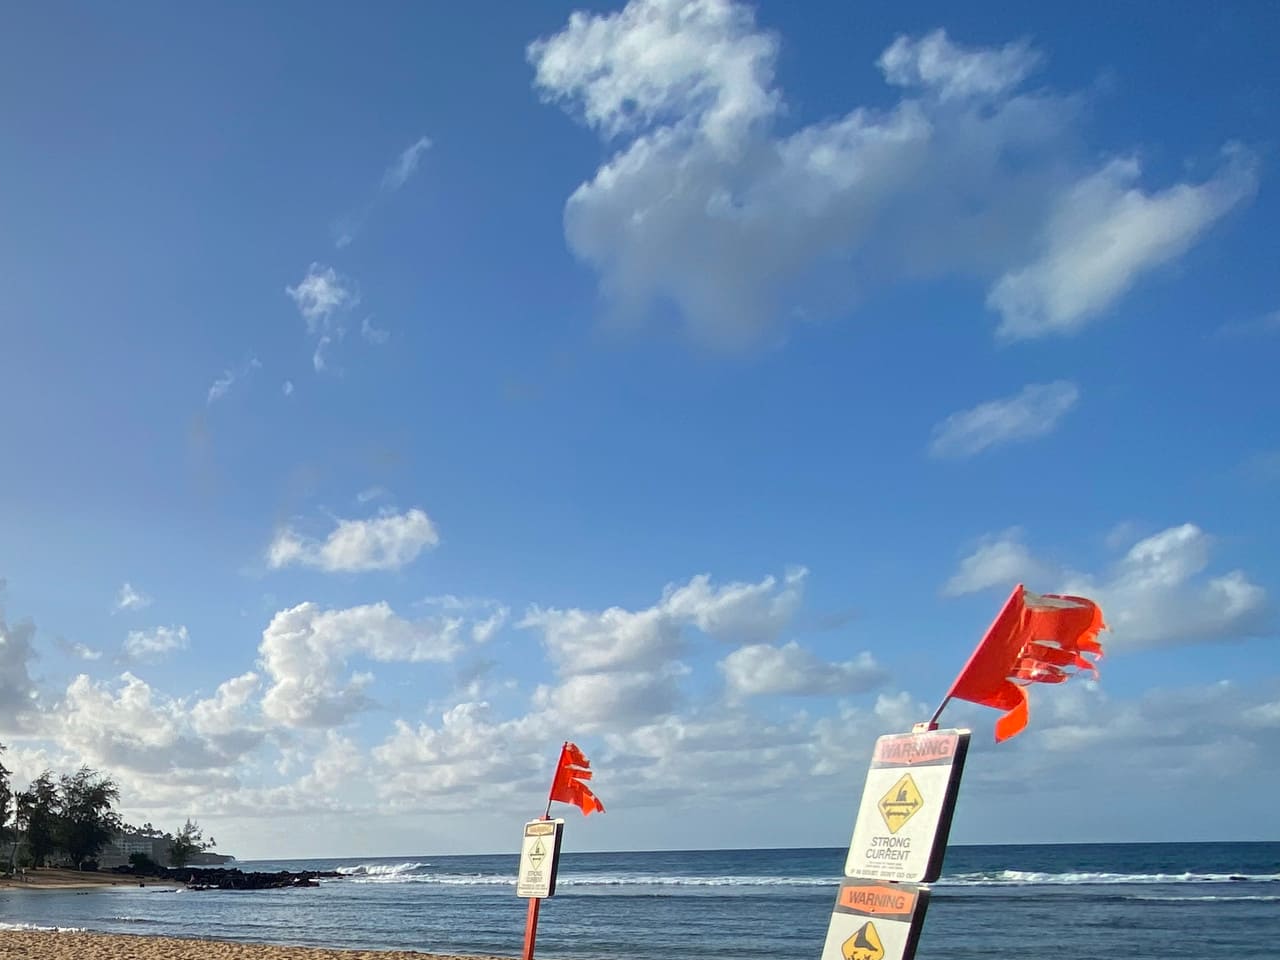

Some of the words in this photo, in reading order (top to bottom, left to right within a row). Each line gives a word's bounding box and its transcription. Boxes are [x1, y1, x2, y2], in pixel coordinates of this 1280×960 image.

[881, 740, 950, 758] WARNING
[871, 836, 911, 848] STRONG
[865, 848, 911, 860] CURRENT
[849, 891, 905, 909] WARNING
